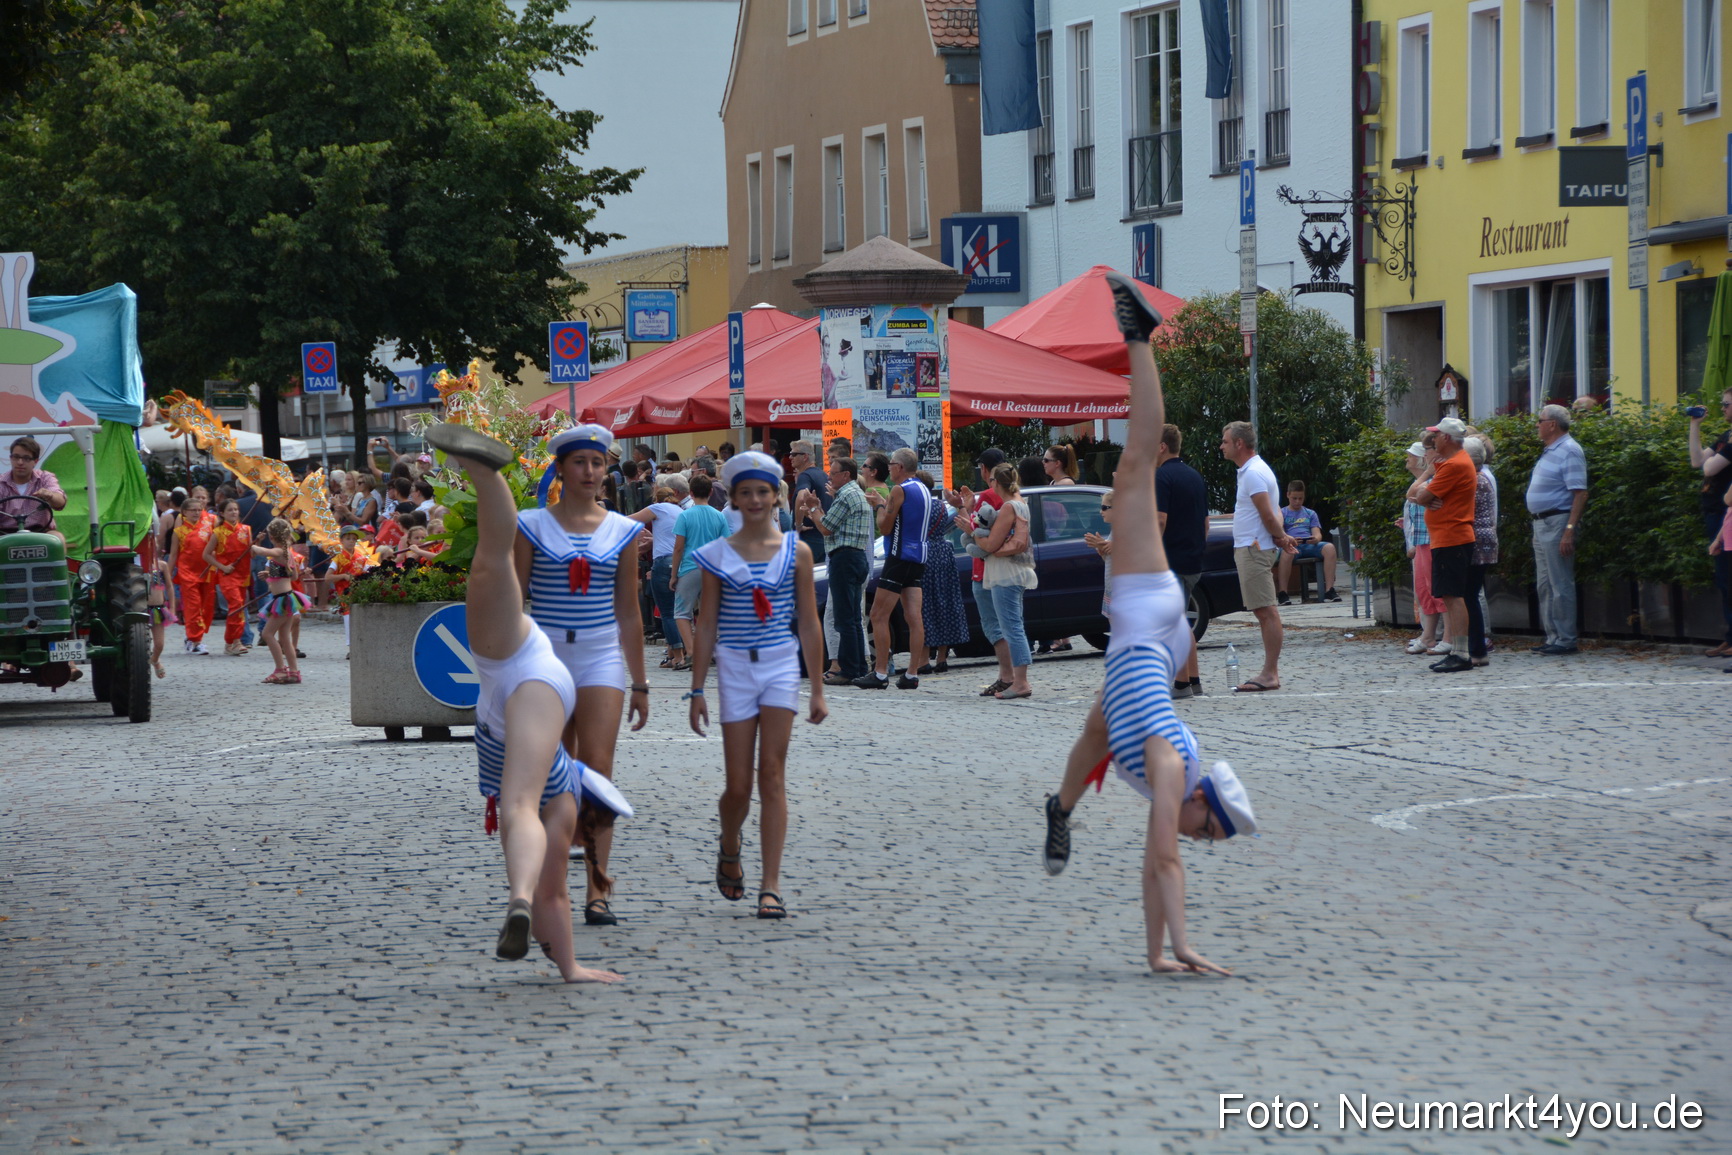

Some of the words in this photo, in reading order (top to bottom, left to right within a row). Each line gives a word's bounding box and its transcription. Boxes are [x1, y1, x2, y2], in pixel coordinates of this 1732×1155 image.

[1630, 87, 1642, 147] P
[1357, 21, 1381, 264] HOTEL
[1243, 168, 1252, 217] P
[952, 225, 1011, 277] K&L
[1480, 212, 1569, 258] Restaurant
[825, 307, 875, 320] NORWEGEN
[731, 321, 740, 363] P
[307, 376, 334, 388] TAXI
[554, 364, 586, 377] TAXI
[768, 399, 823, 422] Glossner
[970, 400, 1002, 411] Hotel
[1005, 401, 1071, 413] Restaurant
[1073, 402, 1131, 414] Lehmeier
[891, 513, 900, 557] YNAMICS
[10, 548, 45, 558] FAHR
[57, 642, 69, 650] NM
